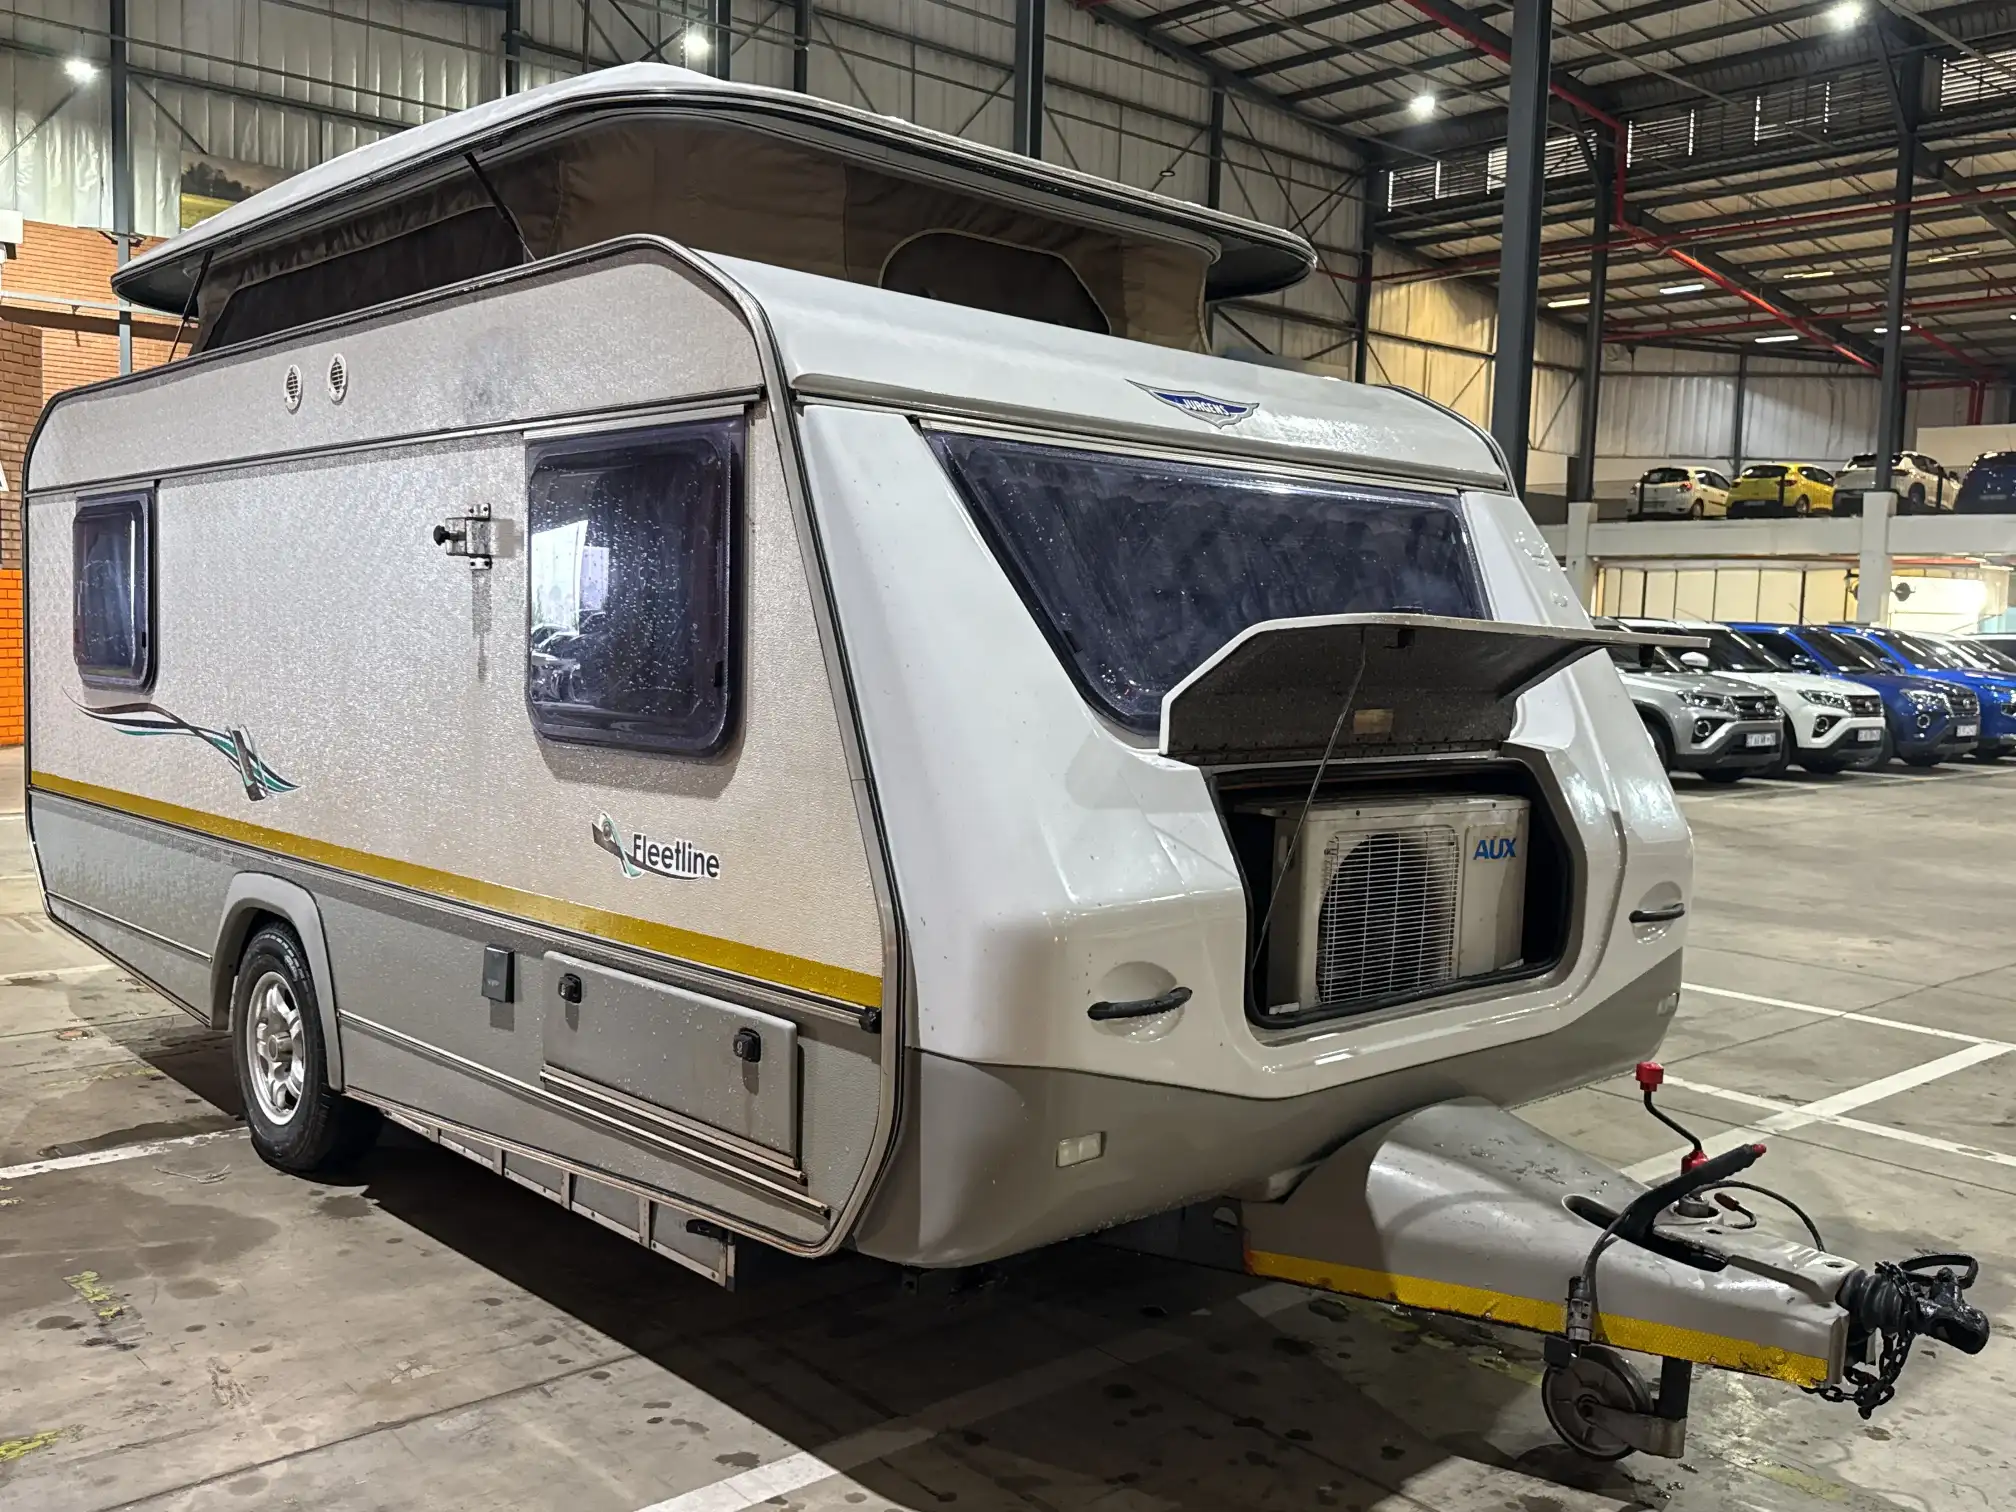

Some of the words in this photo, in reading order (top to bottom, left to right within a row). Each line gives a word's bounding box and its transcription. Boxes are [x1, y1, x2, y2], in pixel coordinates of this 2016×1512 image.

[1182, 398, 1231, 416] JURGENS
[633, 833, 720, 878] Fleetline
[1473, 837, 1517, 860] AUX
